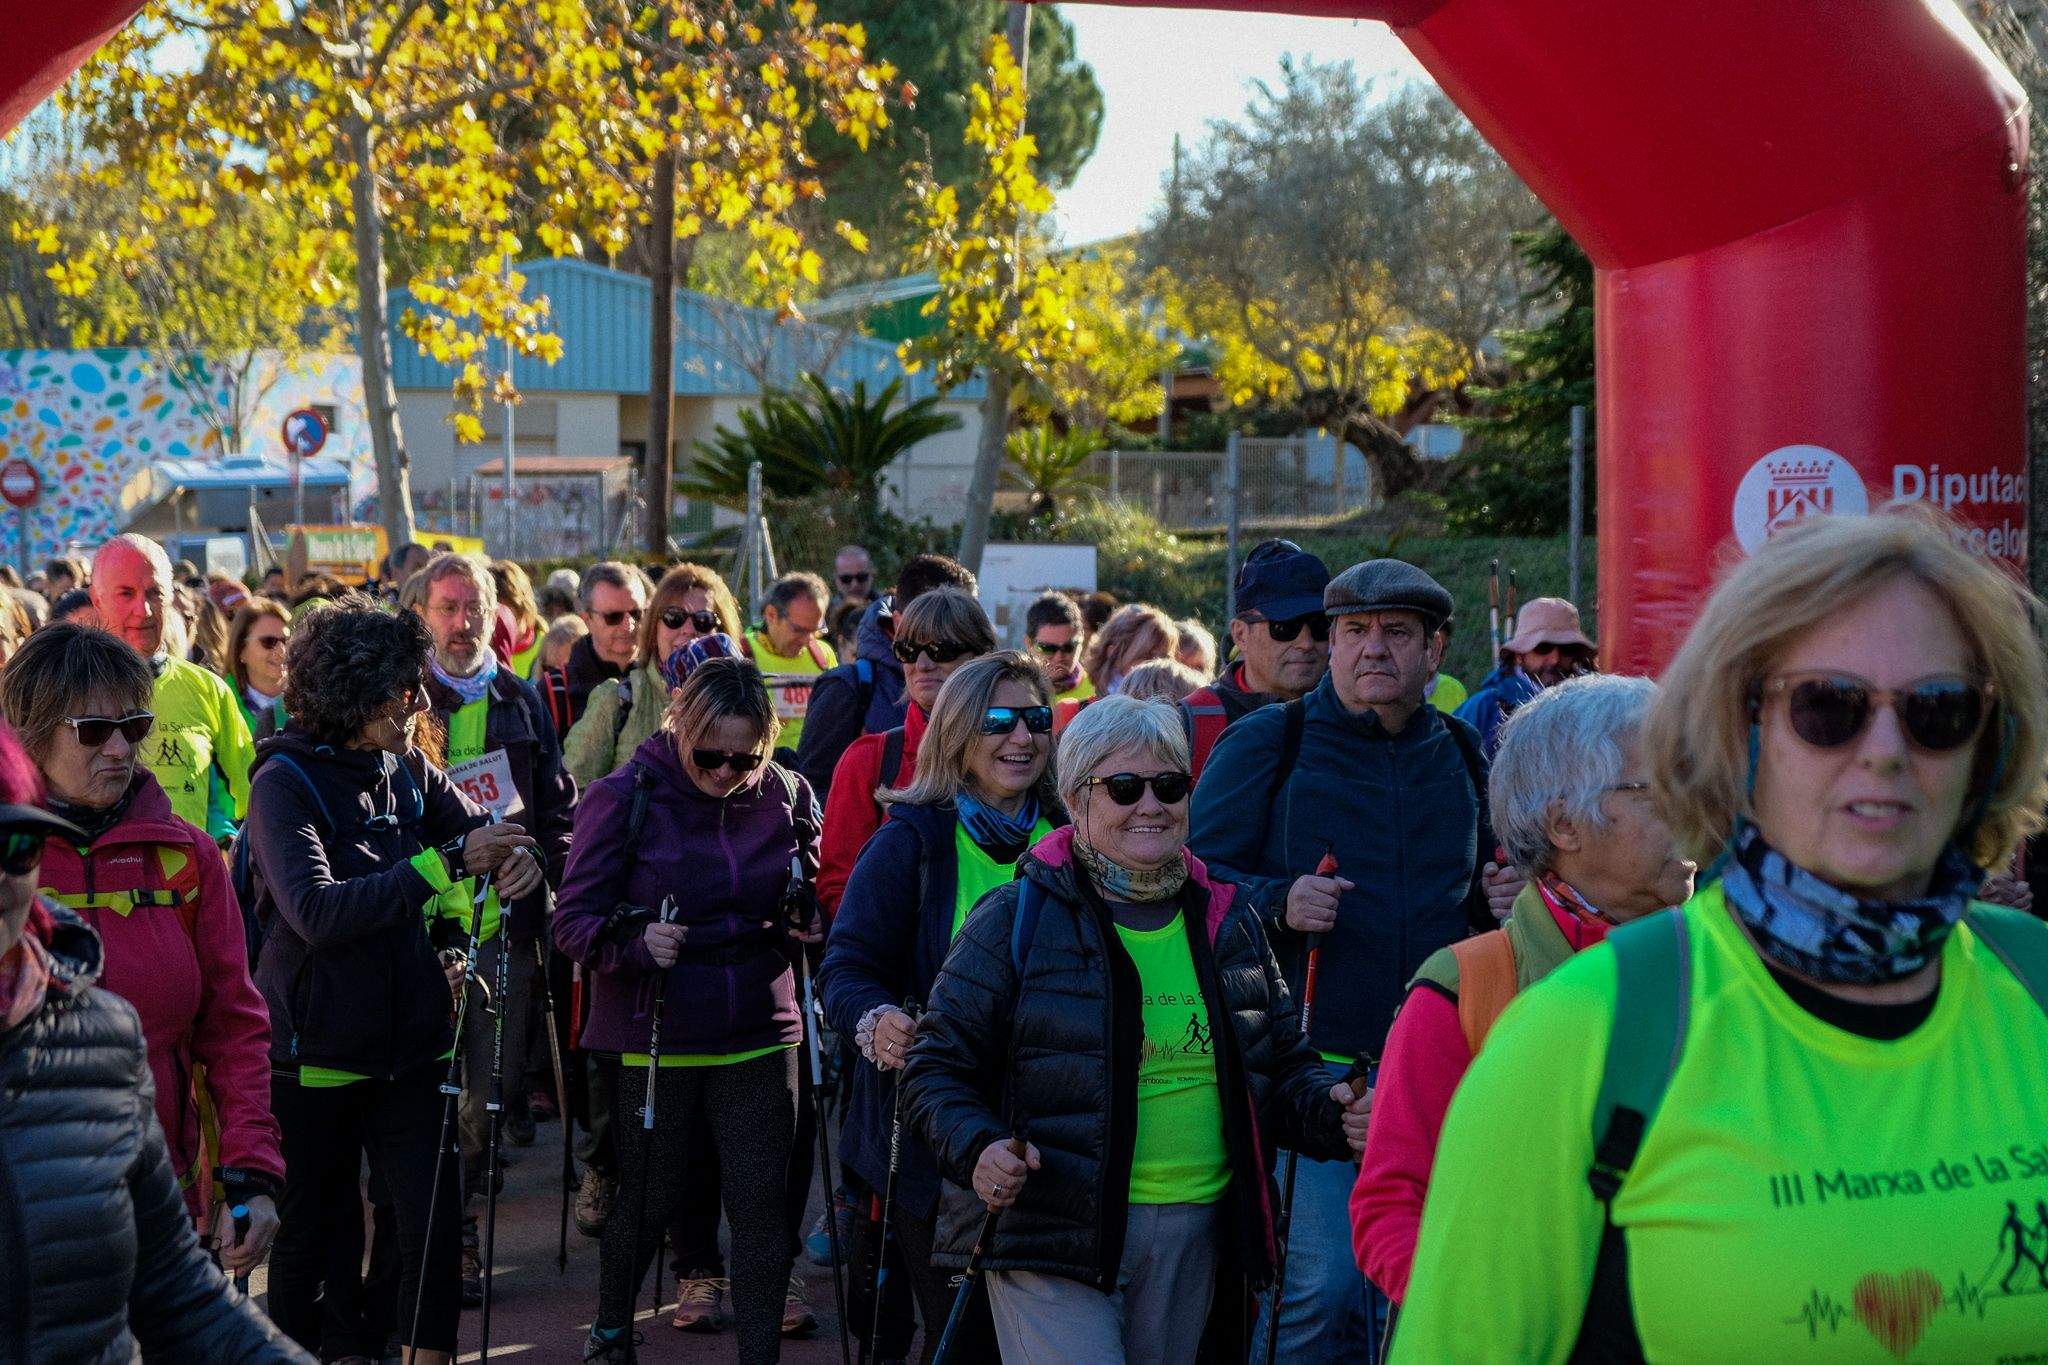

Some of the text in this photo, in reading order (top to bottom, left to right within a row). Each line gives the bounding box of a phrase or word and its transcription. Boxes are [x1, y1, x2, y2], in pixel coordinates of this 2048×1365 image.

[1157, 991, 1177, 1006] de
[1179, 991, 1197, 1006] la
[1813, 1167, 1926, 1204] Marxa
[1929, 1156, 1975, 1191] de
[1973, 1152, 2012, 1185] la
